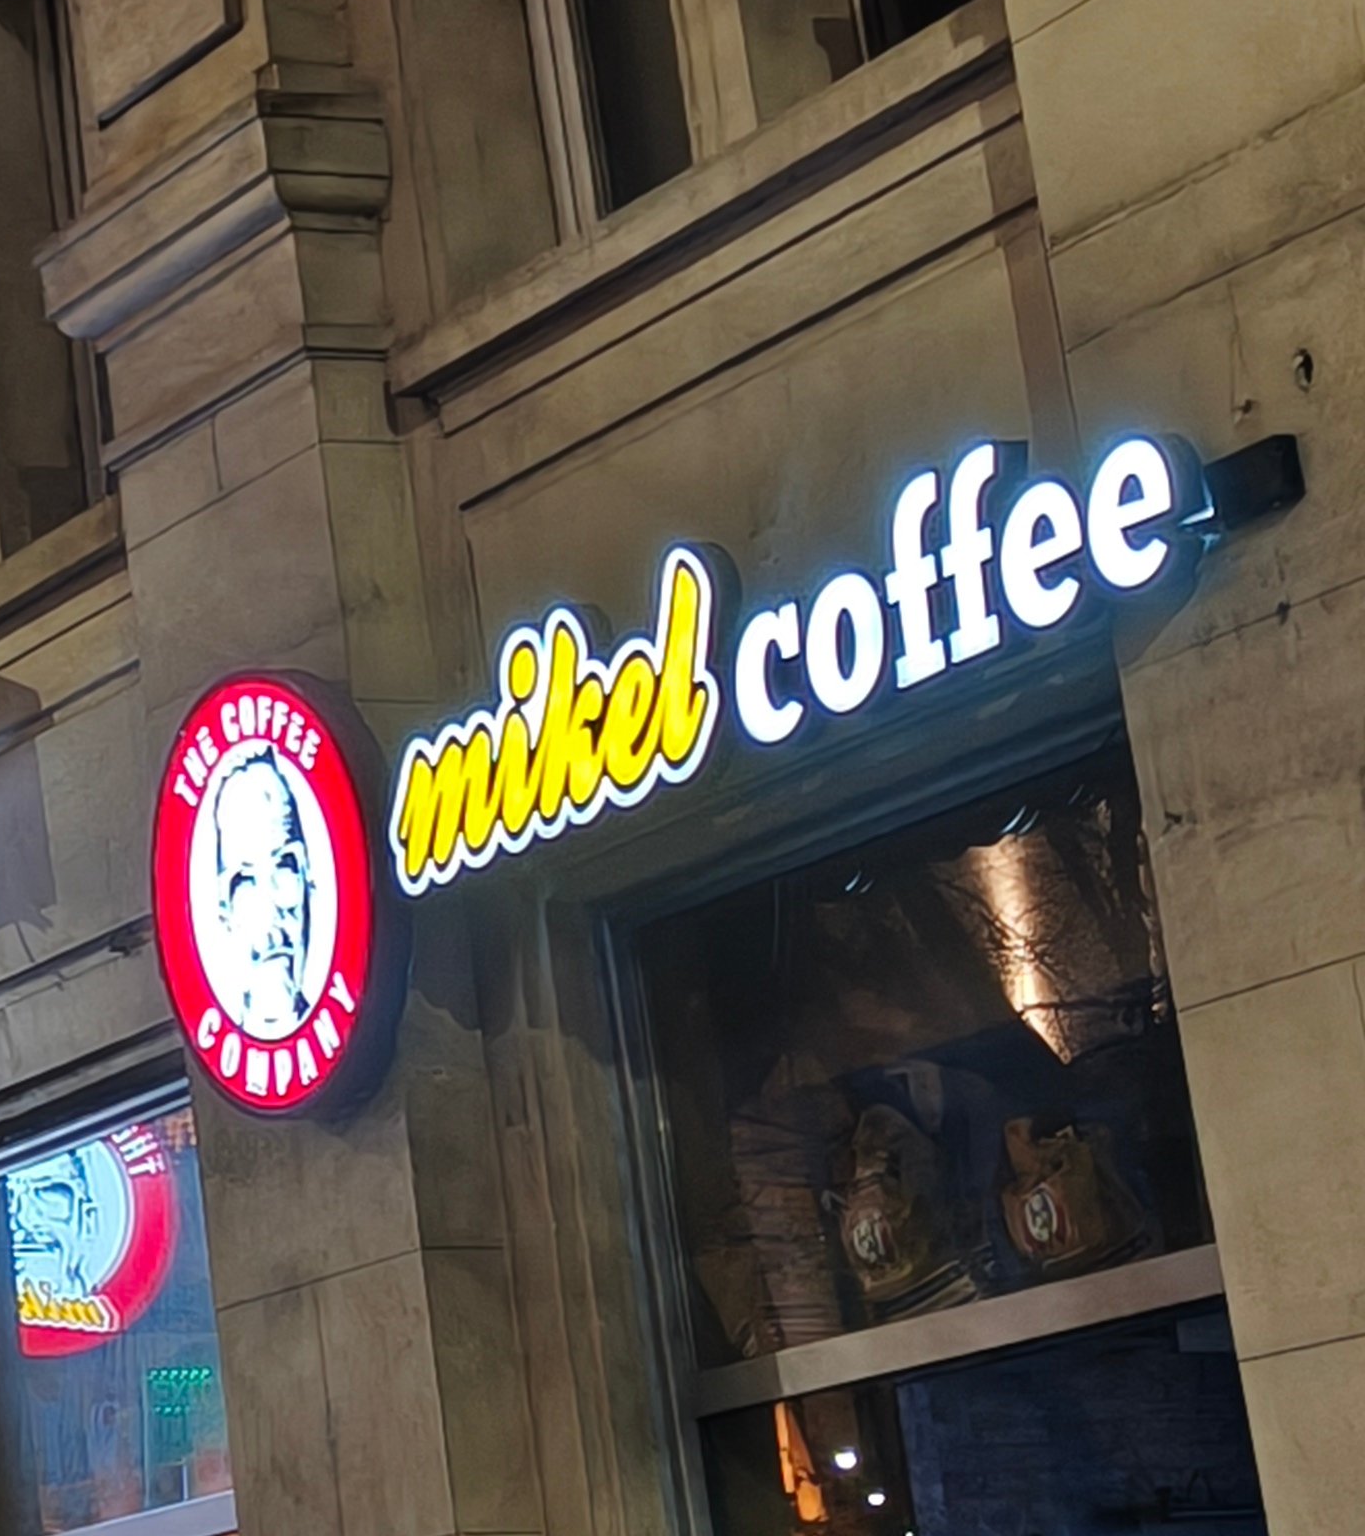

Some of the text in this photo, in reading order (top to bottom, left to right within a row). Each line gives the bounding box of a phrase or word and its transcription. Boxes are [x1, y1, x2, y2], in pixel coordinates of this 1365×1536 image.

[394, 436, 1173, 890] mikel coffee
[173, 695, 322, 807] THE COFFEE
[197, 971, 356, 1096] COMPANY
